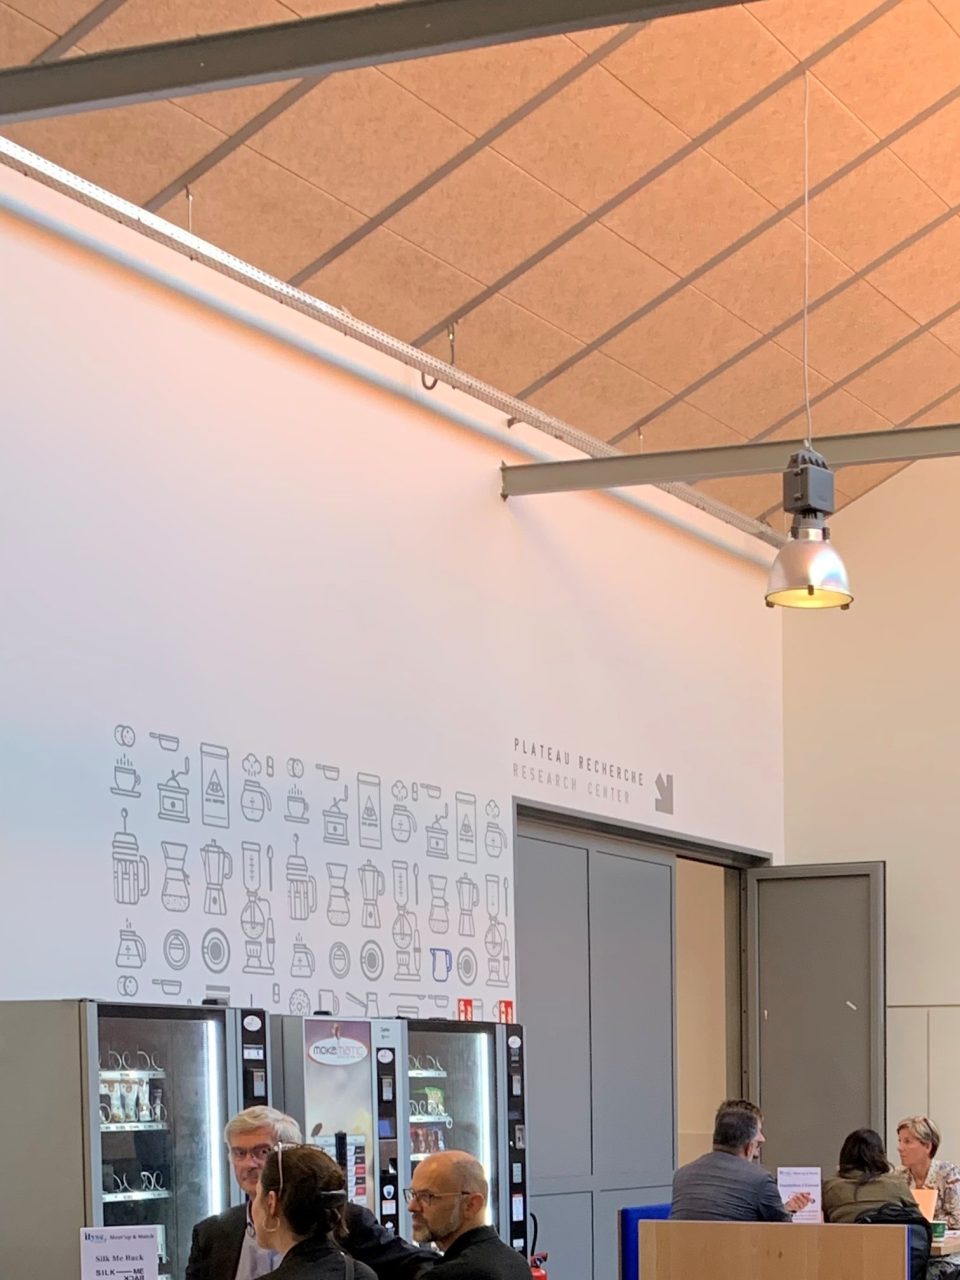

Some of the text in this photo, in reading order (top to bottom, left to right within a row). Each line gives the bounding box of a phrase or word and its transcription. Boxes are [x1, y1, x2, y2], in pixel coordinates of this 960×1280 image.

[513, 763, 630, 804] RESEARCH CENTER
[514, 737, 644, 786] PLATEAU RECHERCHE
